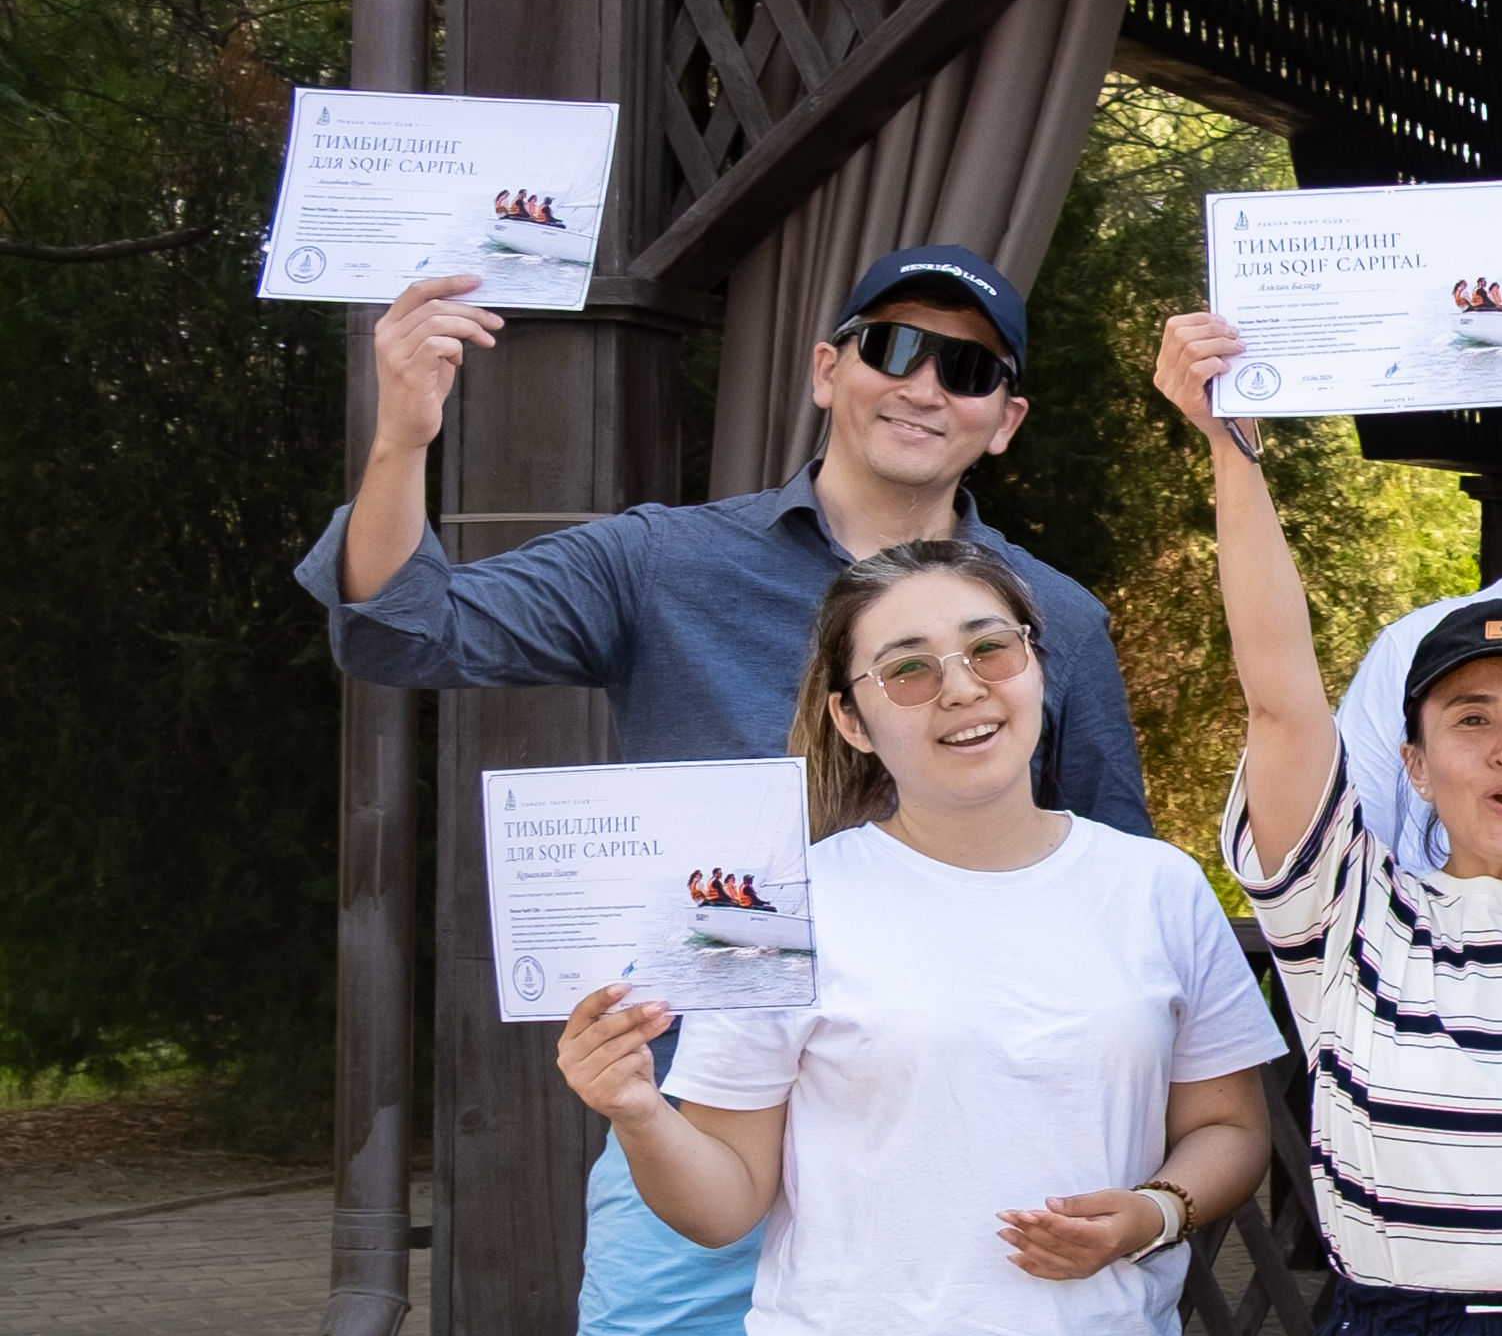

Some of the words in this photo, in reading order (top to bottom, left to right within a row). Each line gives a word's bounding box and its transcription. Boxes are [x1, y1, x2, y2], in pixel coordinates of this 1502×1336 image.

[313, 134, 461, 155] ТИМБИЛДИНГ
[399, 159, 479, 176] CAPITAL
[1233, 233, 1401, 256] ТИМБИЛДИНГ
[1235, 261, 1274, 278] ДЛЯ
[1280, 259, 1328, 277] SQIF
[1336, 253, 1427, 272] CAPITAL
[504, 815, 641, 839] ТИМБИЛДИНГ
[504, 847, 534, 862] ДЛЯ
[539, 844, 576, 863] SQIF
[583, 839, 663, 858] CAPITAL
